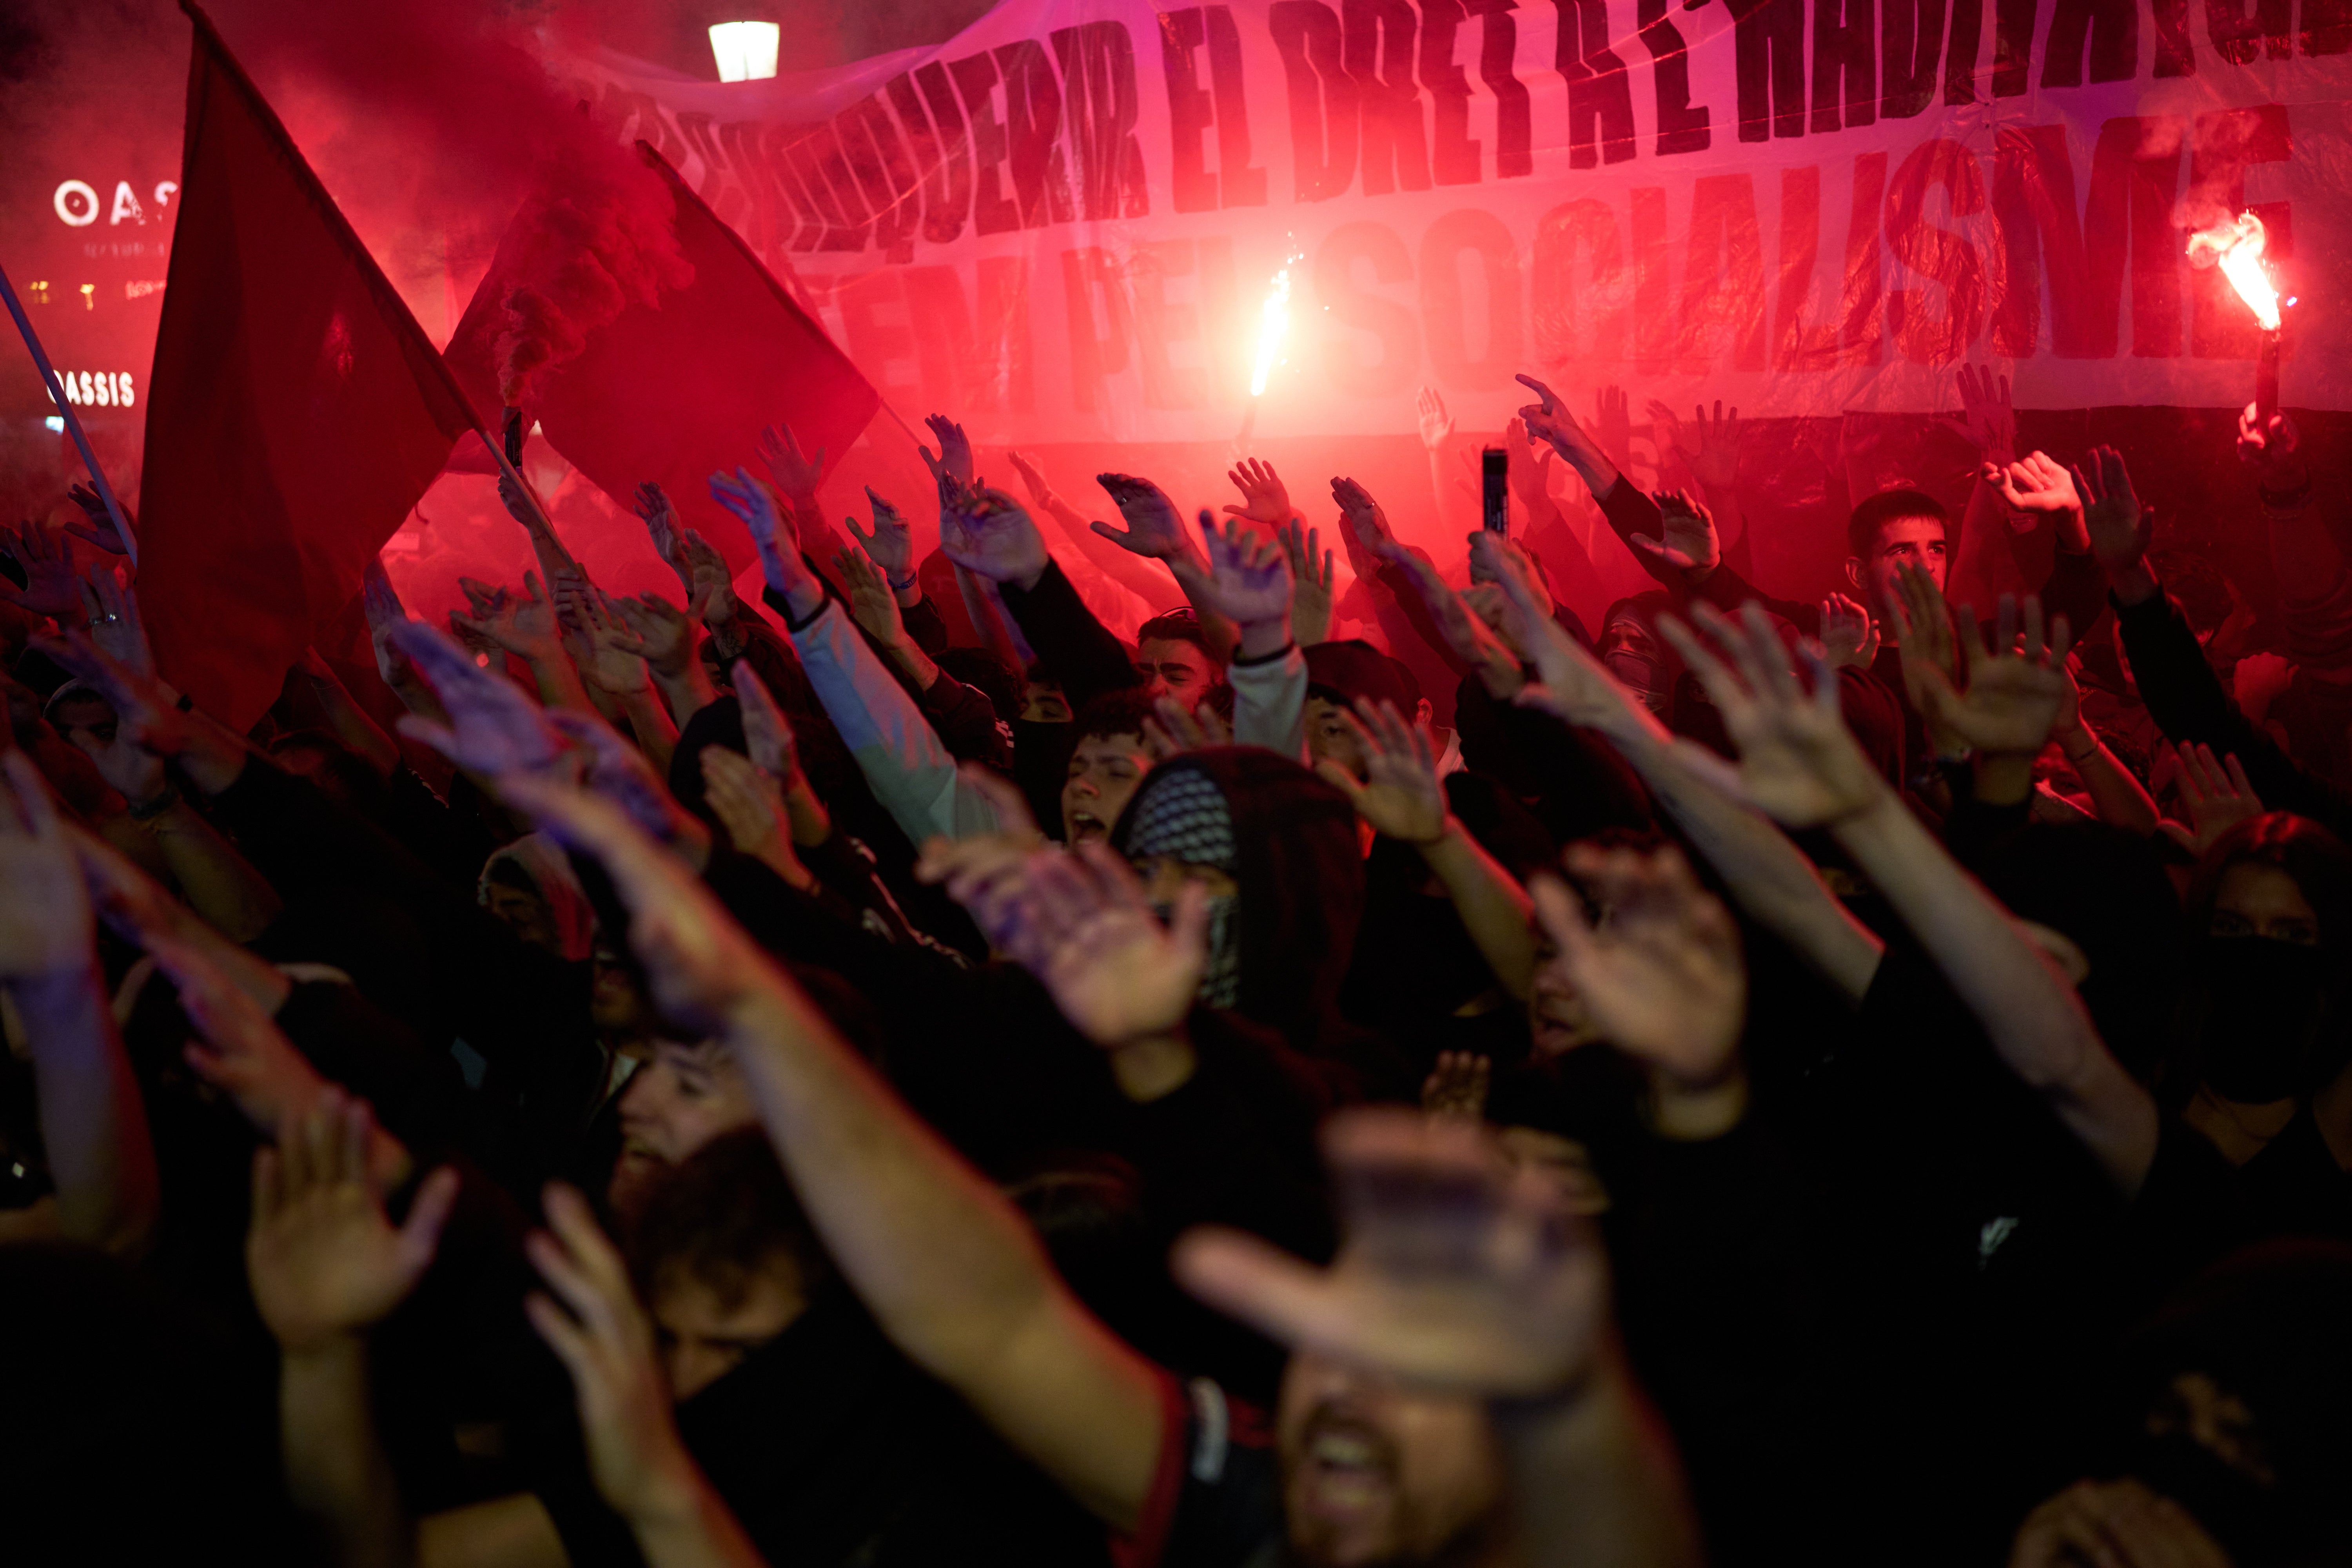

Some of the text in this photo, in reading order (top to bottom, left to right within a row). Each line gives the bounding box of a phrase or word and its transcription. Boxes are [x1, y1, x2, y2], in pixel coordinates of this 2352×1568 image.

[1156, 4, 1268, 214] EL
[1269, 0, 1534, 205] DRET
[1060, 235, 1256, 415] PEL
[1312, 102, 2298, 399] SOCIALISME
